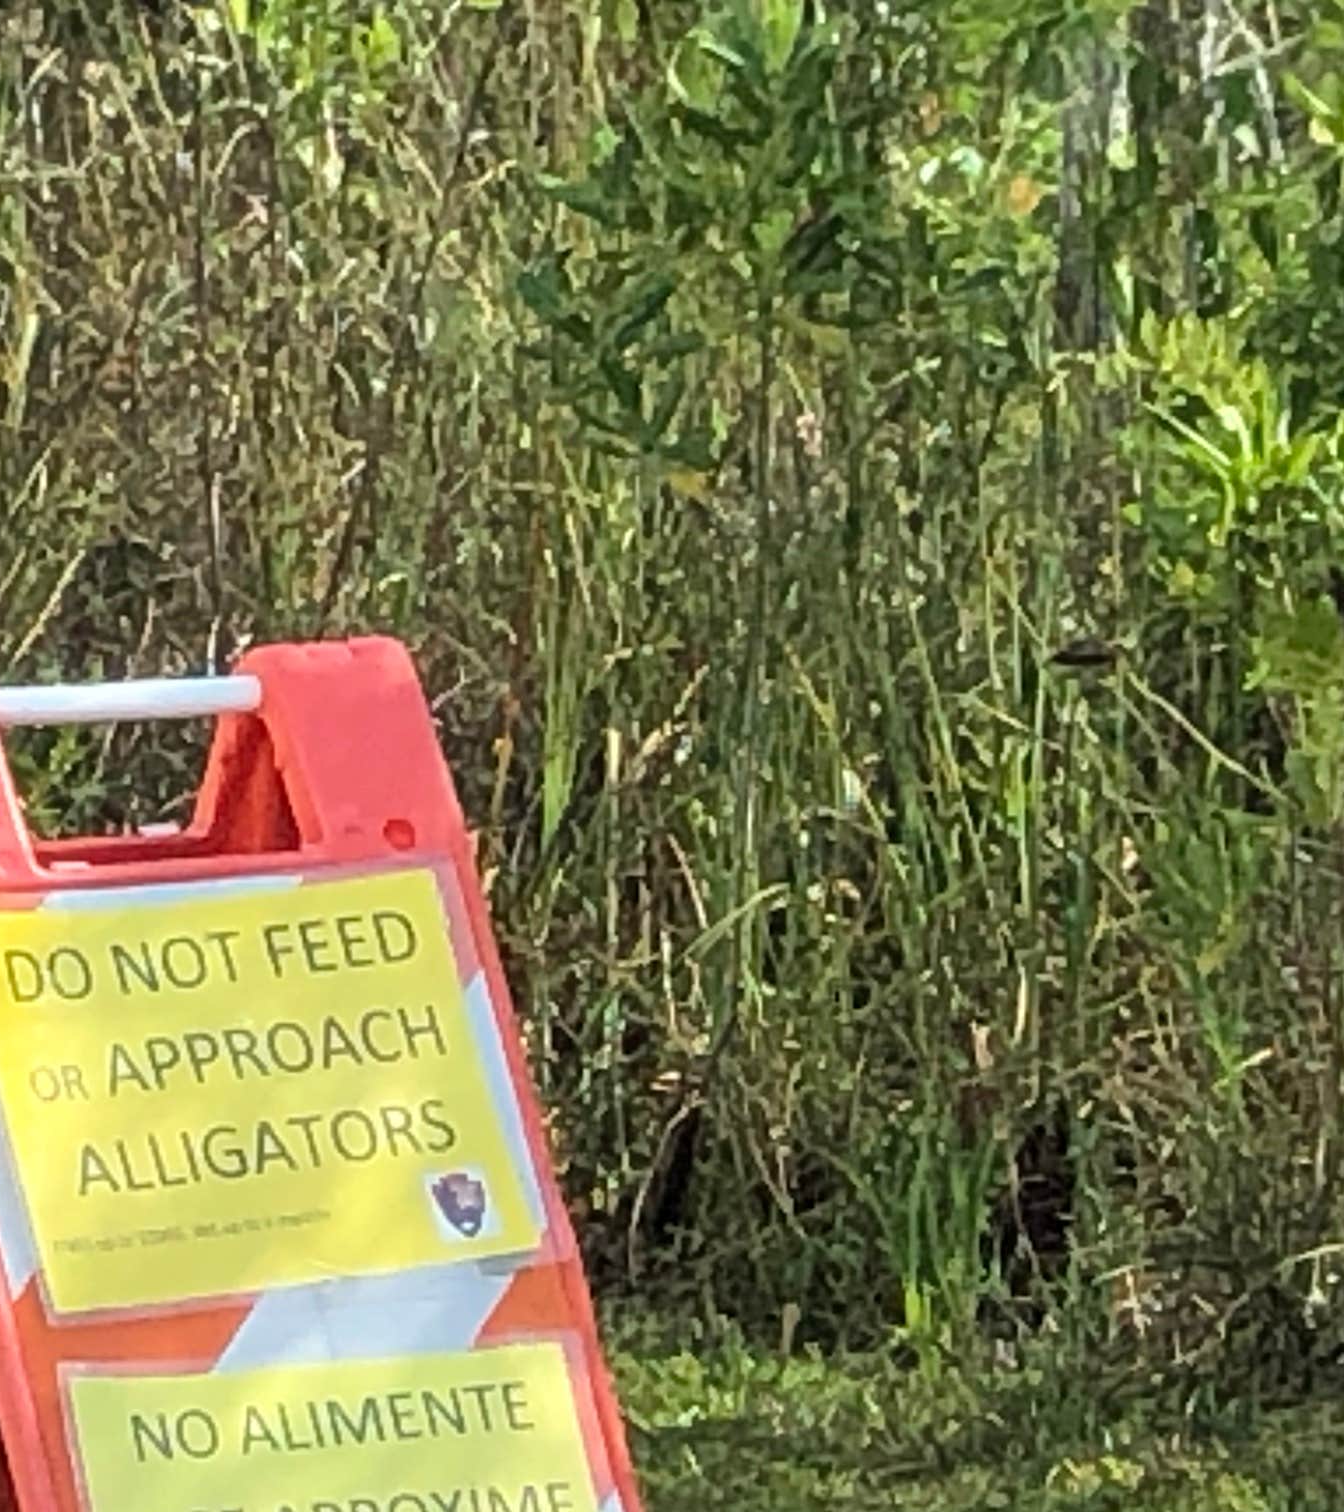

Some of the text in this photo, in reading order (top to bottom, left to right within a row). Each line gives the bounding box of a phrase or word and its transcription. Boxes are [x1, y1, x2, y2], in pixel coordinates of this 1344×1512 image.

[3, 910, 417, 1003] DO NOT FEED
[30, 1005, 447, 1103] OR APPROACH
[77, 1100, 456, 1197] ALLIGATORS
[131, 1381, 534, 1462] NO ALIMENTE
